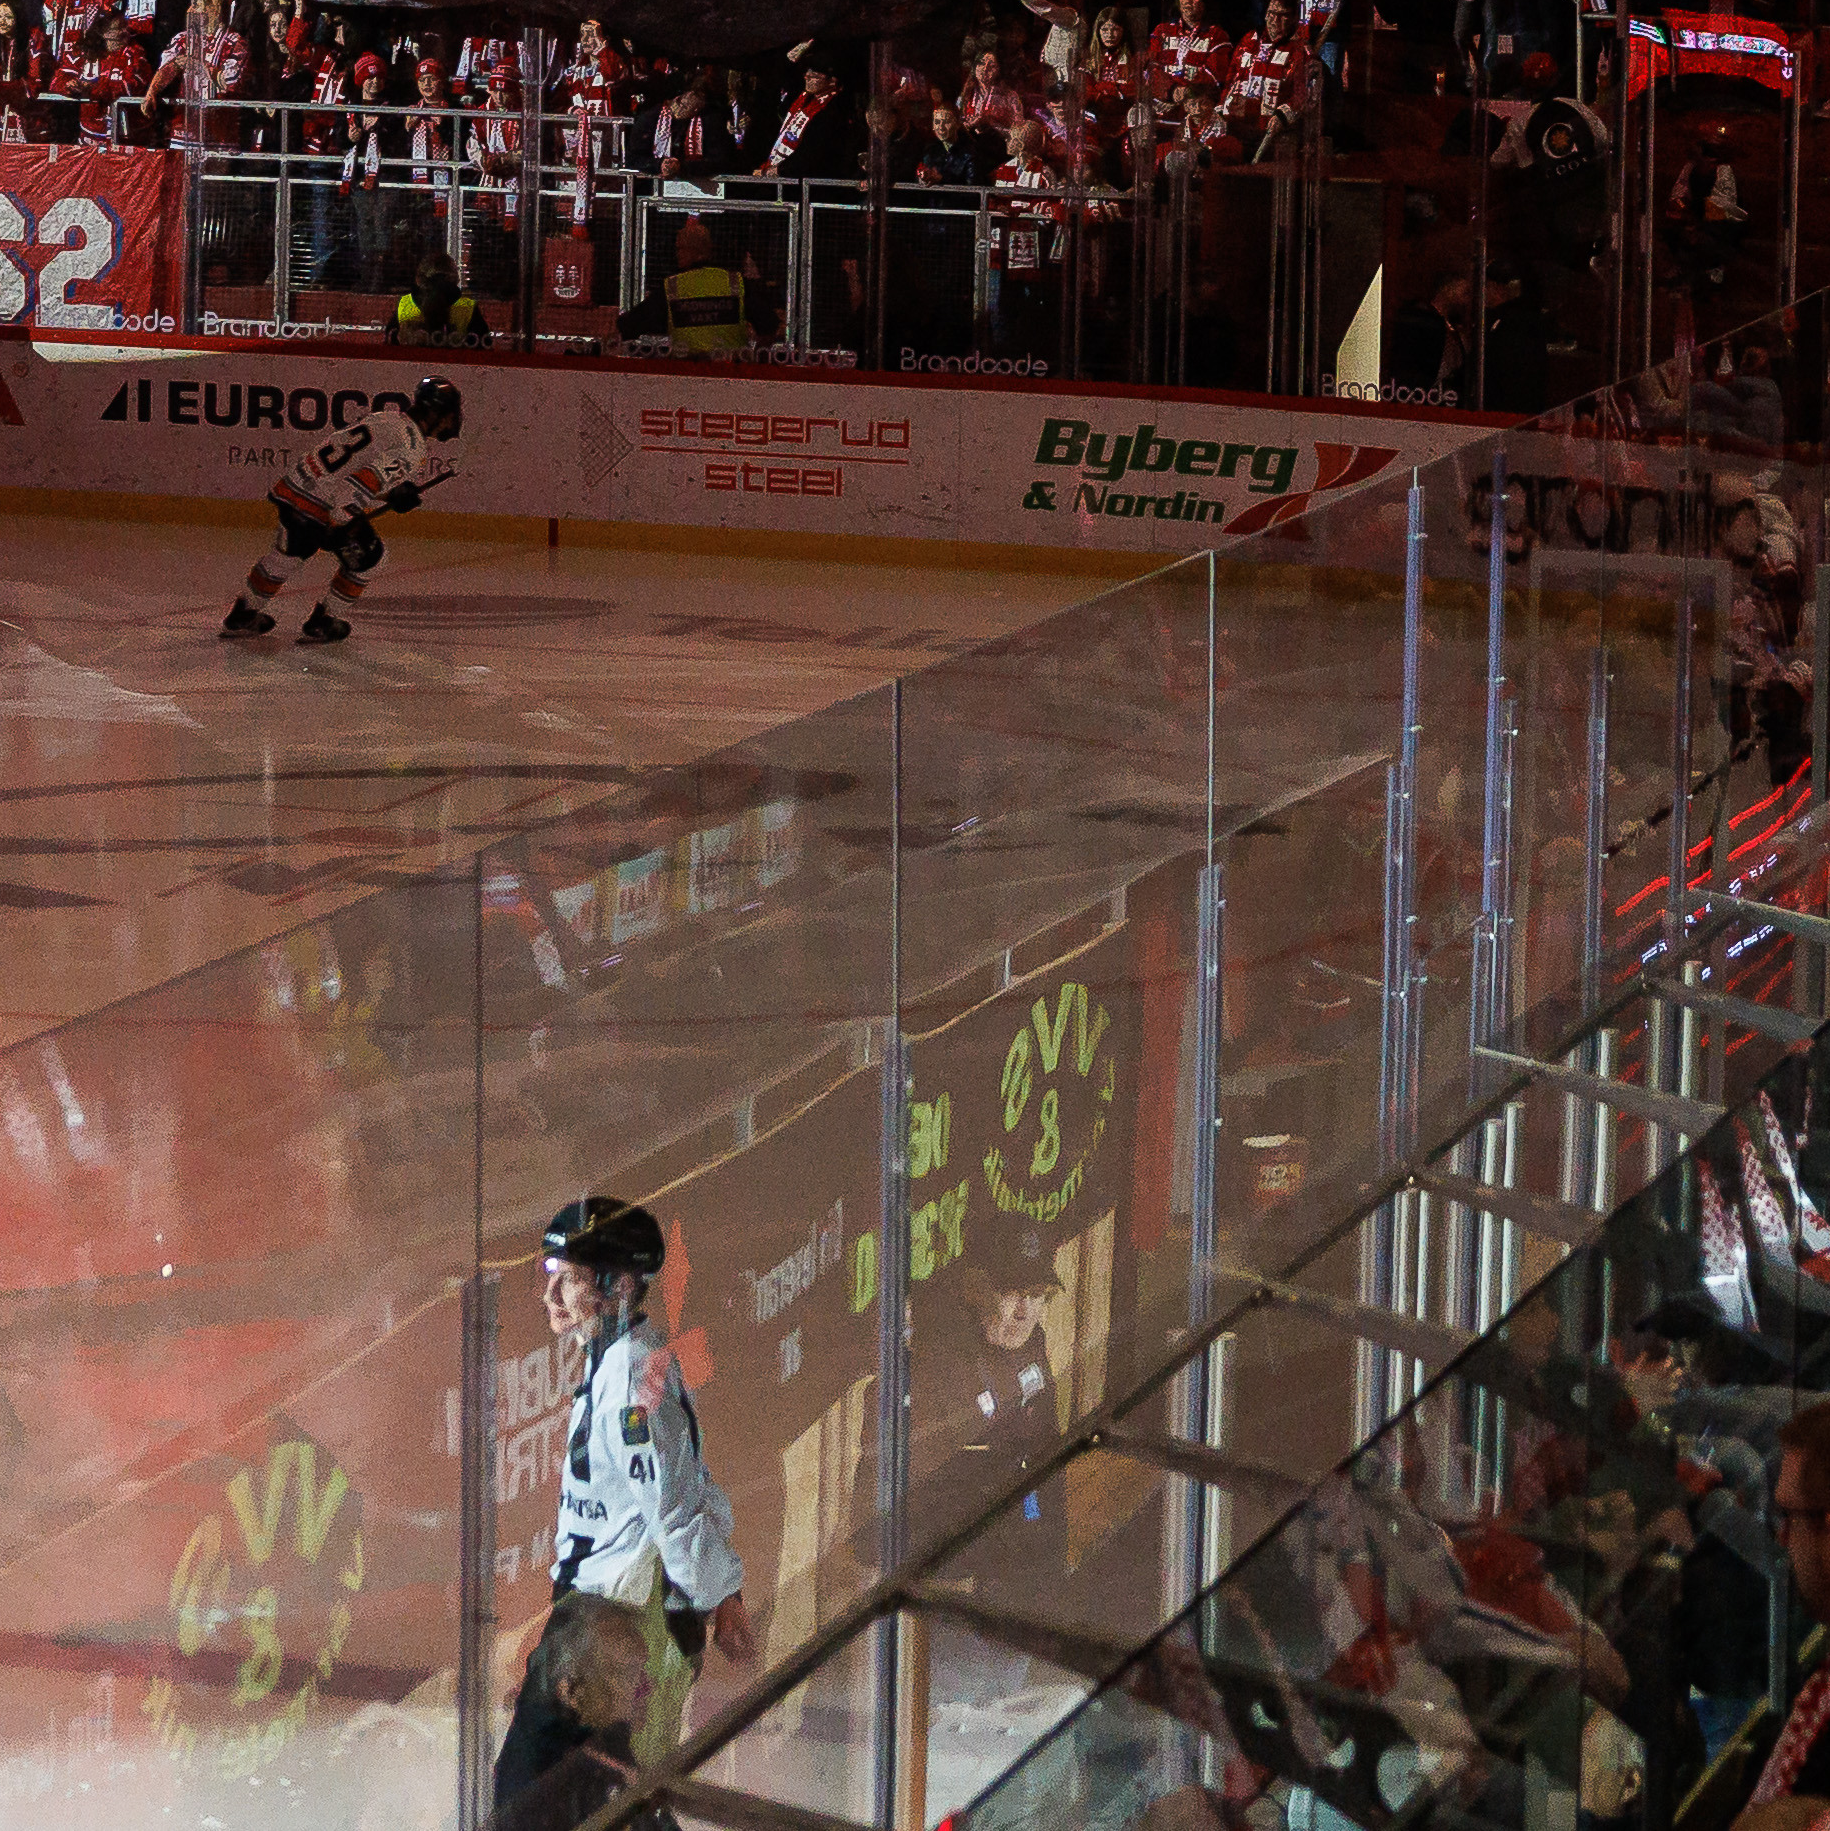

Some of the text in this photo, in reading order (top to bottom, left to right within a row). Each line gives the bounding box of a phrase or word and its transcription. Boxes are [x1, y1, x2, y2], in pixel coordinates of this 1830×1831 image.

[900, 346, 1049, 377] Brandcode
[640, 406, 911, 451] stegerud
[1035, 416, 1299, 495] Byberg
[704, 461, 844, 498] steel
[1022, 479, 1226, 525] & Nordin
